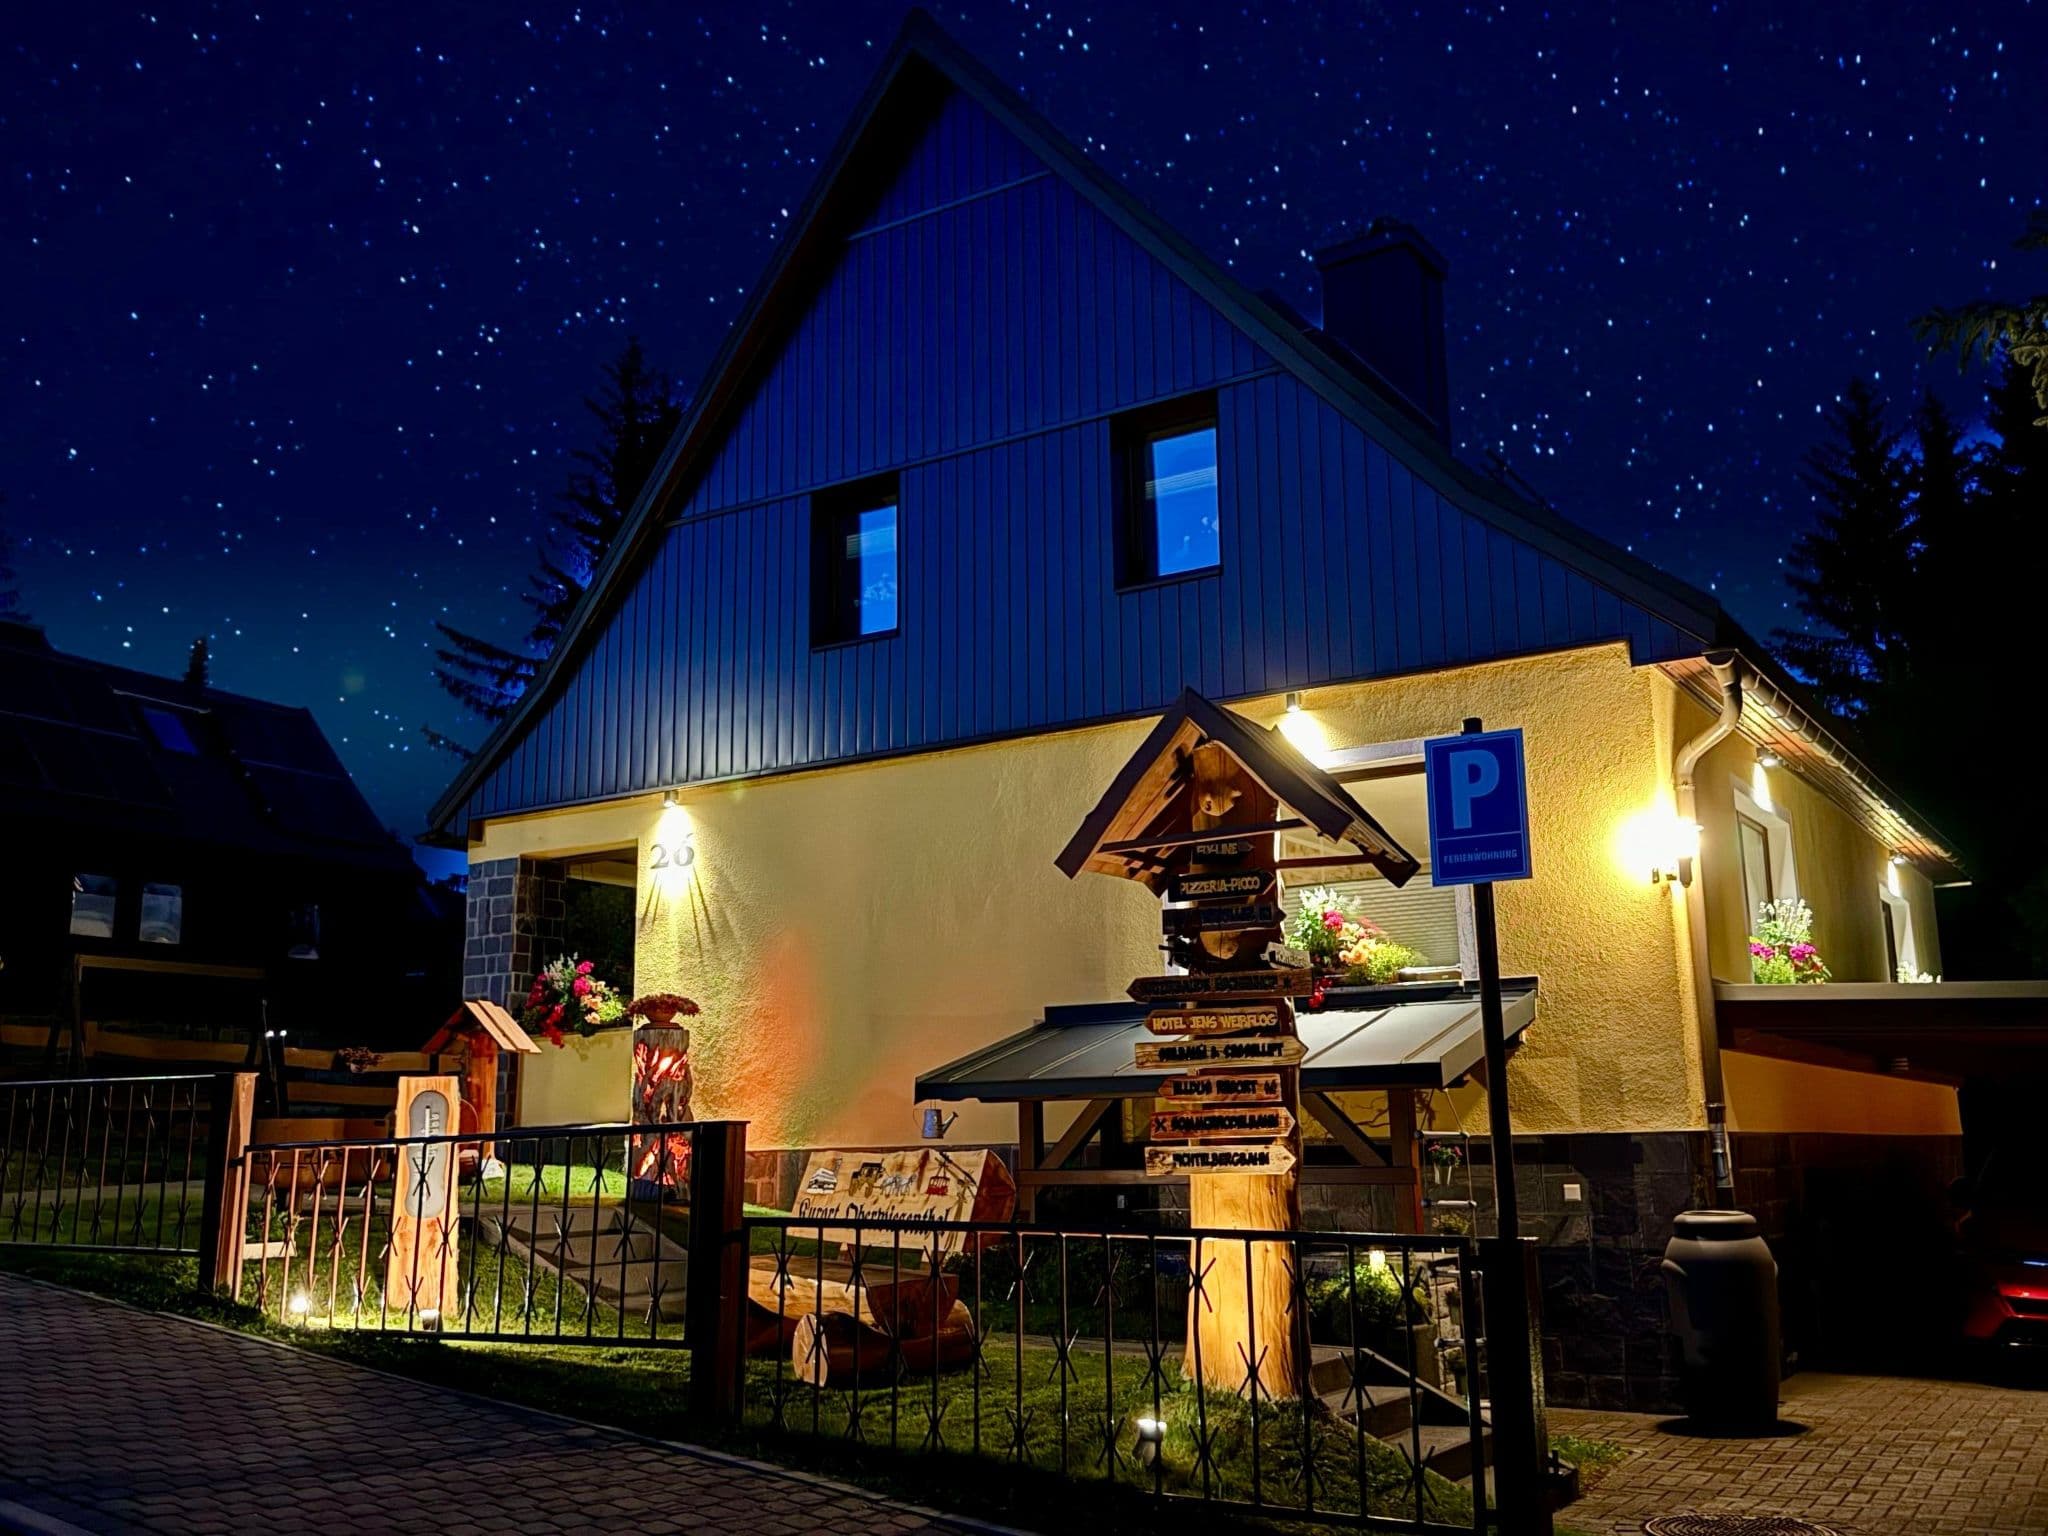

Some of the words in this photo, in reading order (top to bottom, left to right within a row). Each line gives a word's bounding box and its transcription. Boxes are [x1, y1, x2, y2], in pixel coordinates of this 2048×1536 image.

[1449, 749, 1500, 830] P
[650, 833, 695, 869] 26
[1443, 848, 1518, 864] FERIENWOHNUNG
[1152, 1017, 1187, 1031] HOTEL
[1189, 1014, 1218, 1030] JENS
